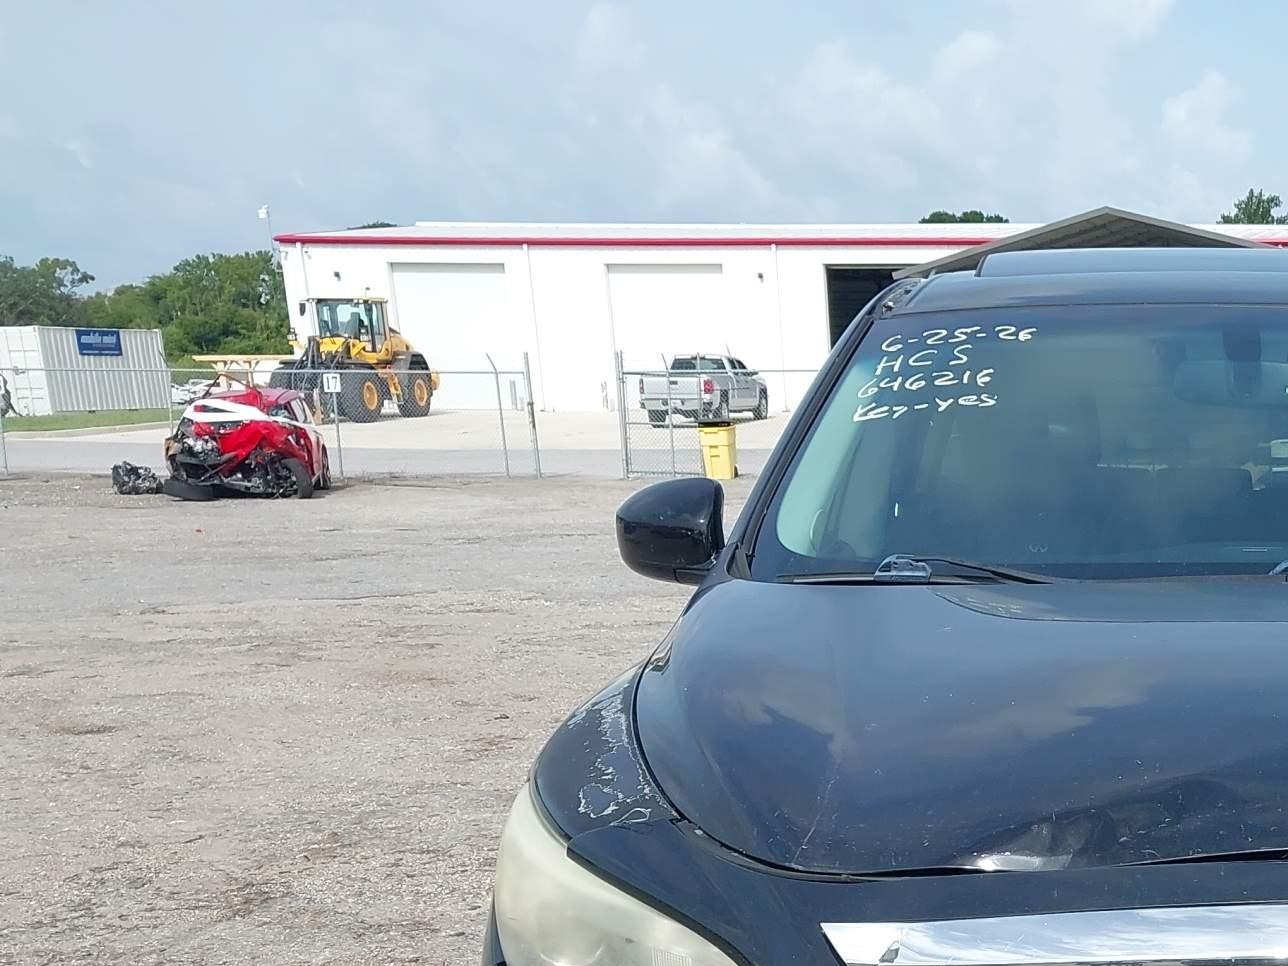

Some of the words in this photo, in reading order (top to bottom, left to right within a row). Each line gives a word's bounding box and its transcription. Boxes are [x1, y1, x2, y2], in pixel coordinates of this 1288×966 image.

[881, 325, 1037, 352] 6-25-26
[326, 375, 338, 390] 17
[857, 368, 995, 398] 646216
